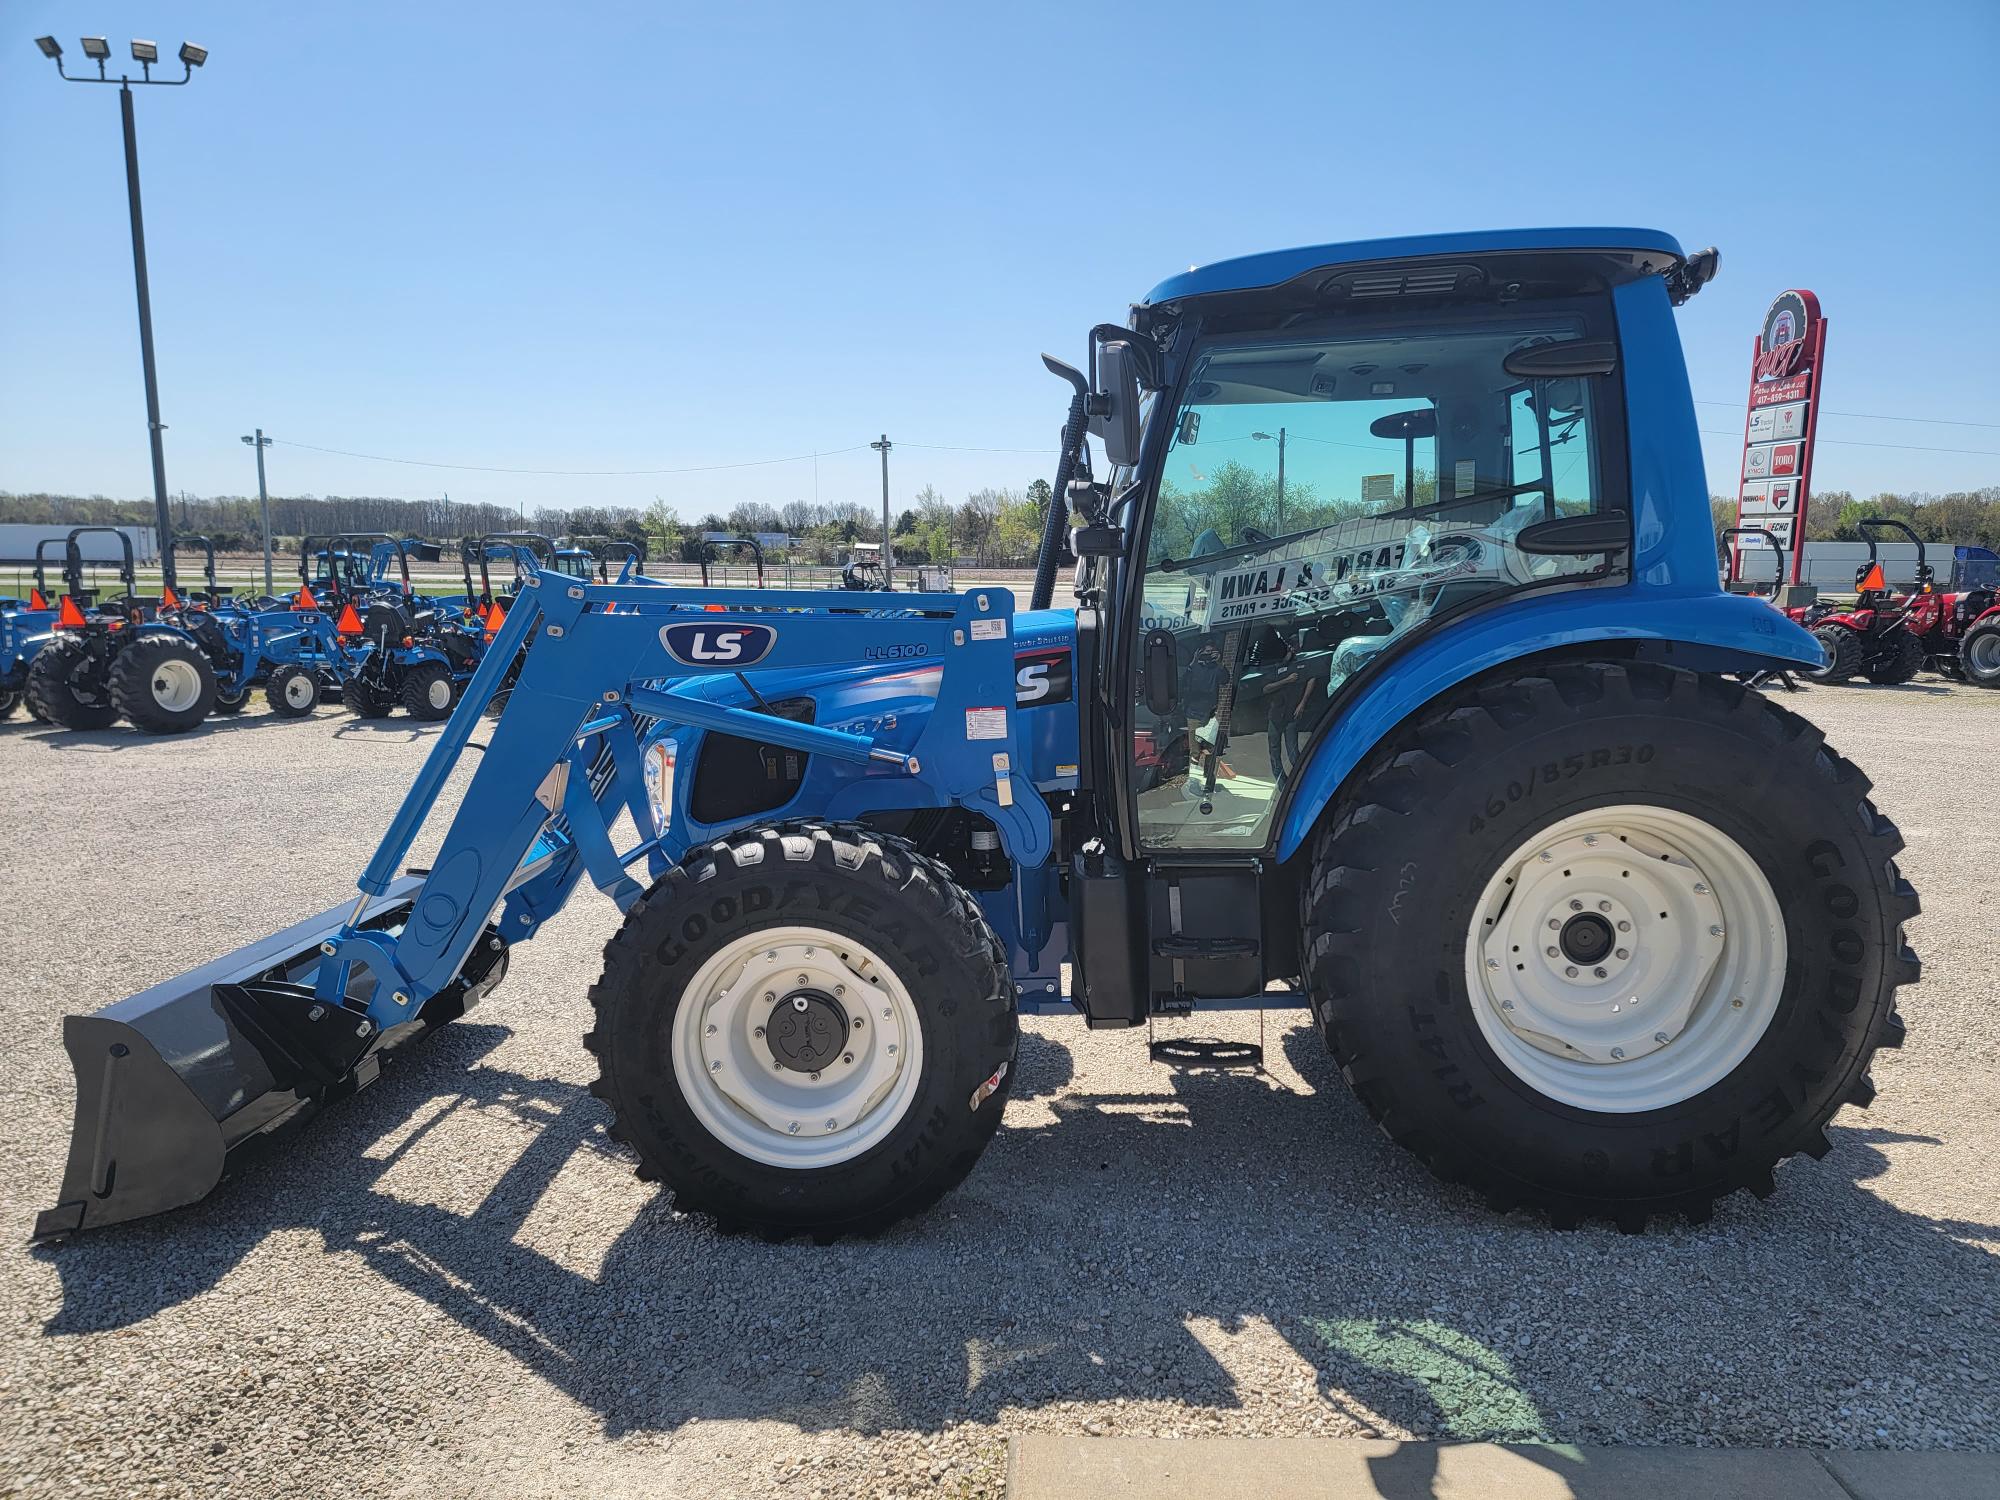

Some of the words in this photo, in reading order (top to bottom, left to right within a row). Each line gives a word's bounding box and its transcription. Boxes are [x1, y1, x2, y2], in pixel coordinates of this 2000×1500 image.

[1750, 416, 1760, 427] LS
[1775, 454, 1794, 466] TORO
[691, 632, 742, 660] LS
[864, 643, 929, 660] LL6100
[1013, 635, 1070, 649] owerShuttle
[1015, 663, 1050, 702] S
[1468, 743, 1656, 836] 460/85R30
[656, 880, 940, 979] GOODYEAR
